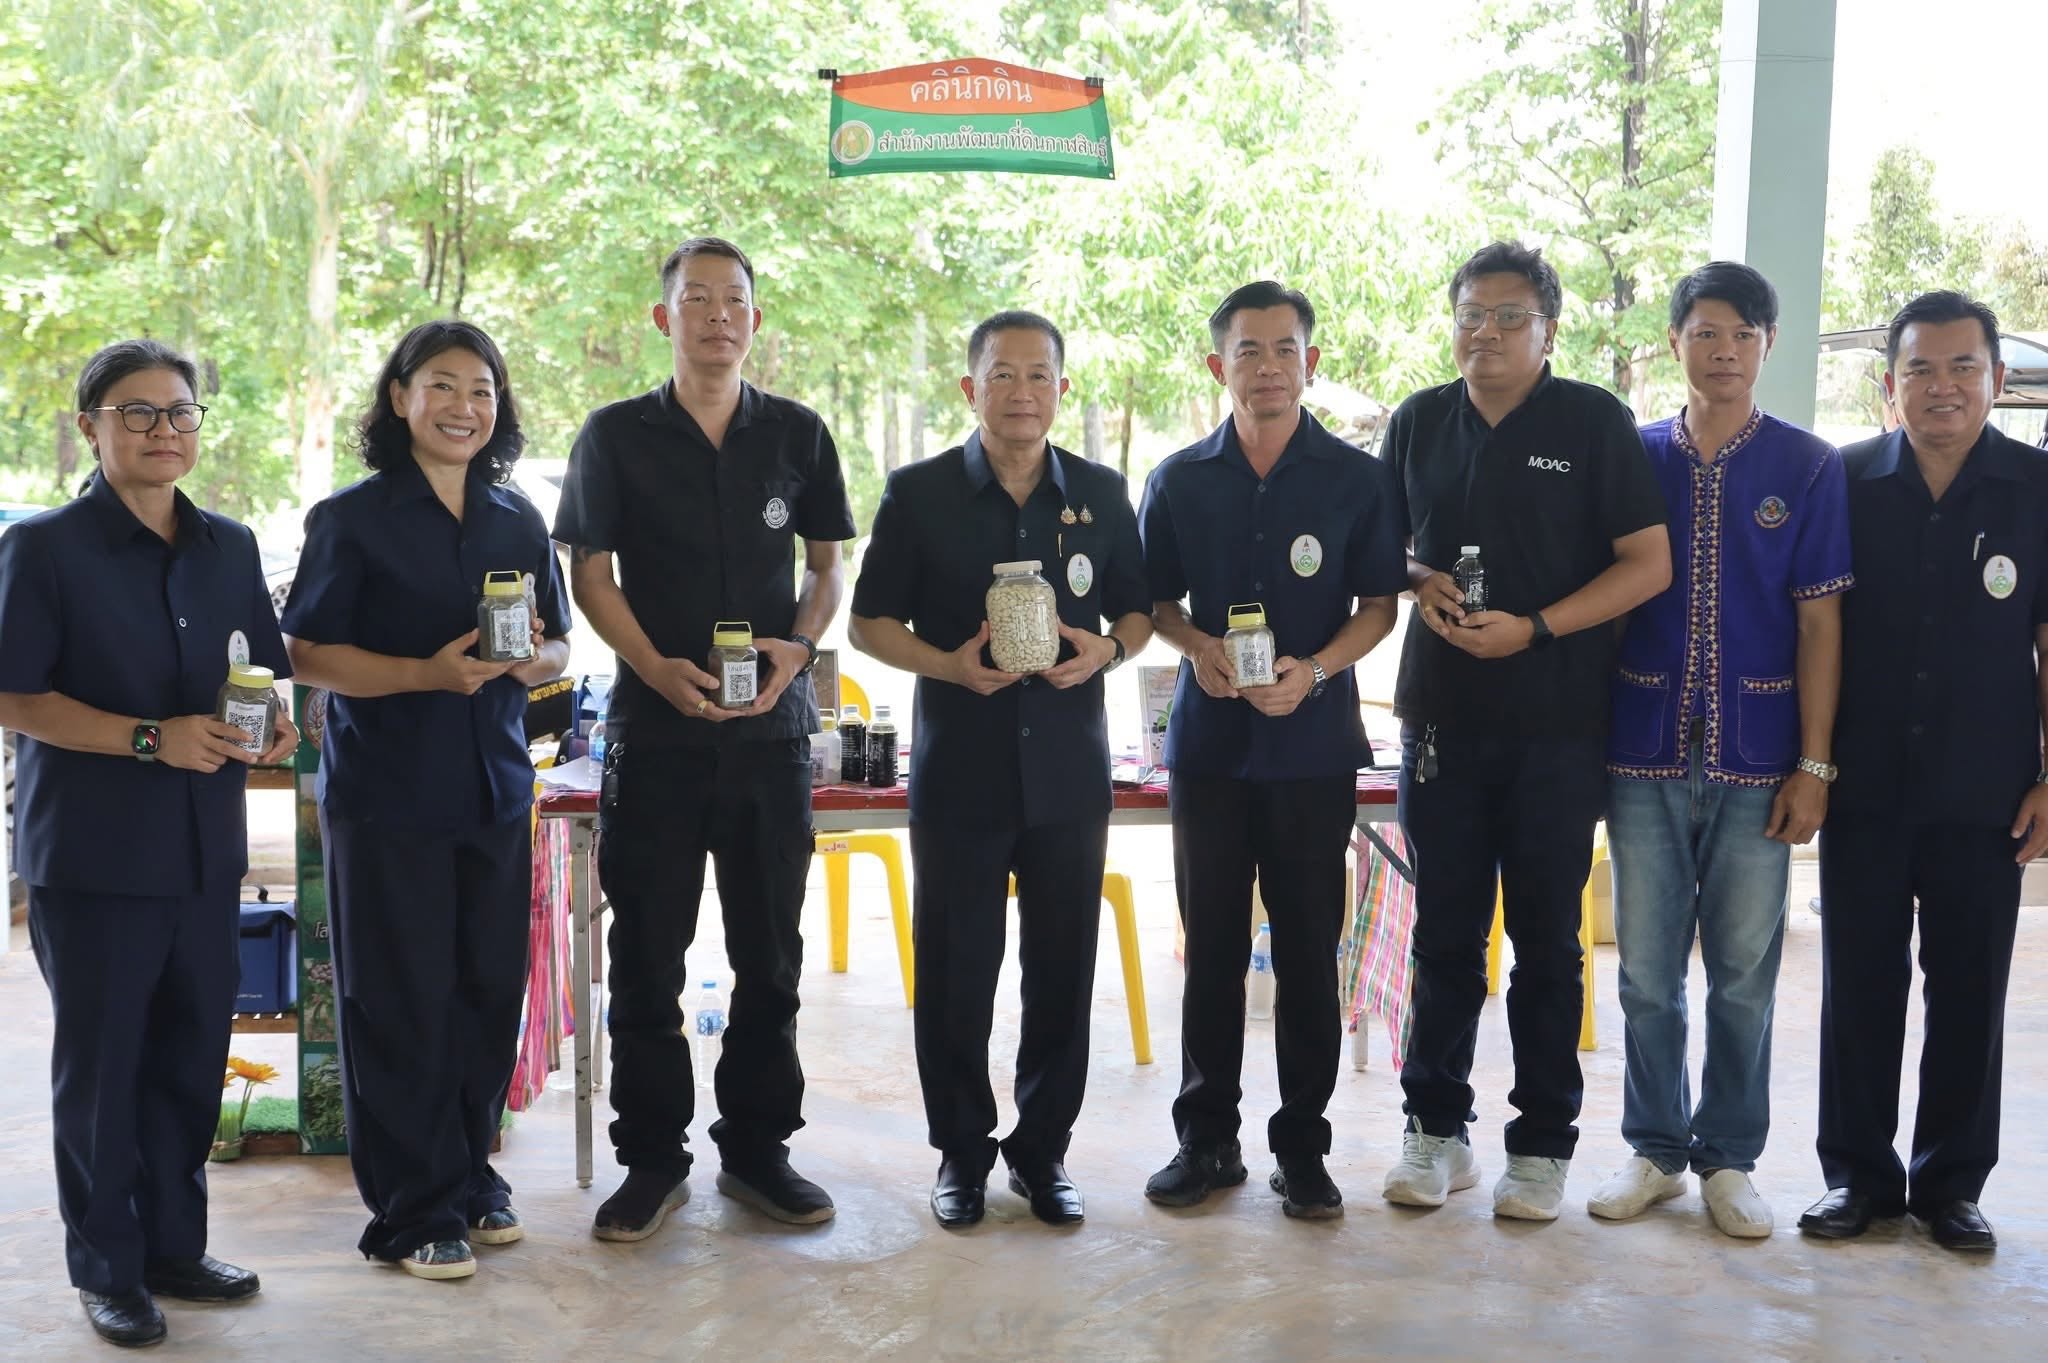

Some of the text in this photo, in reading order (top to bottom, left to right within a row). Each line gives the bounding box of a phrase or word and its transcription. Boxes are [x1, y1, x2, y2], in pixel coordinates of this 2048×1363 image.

[910, 66, 1033, 104] คลินิกดิน
[878, 119, 1109, 166] สำนักงานพัฒนาที่ดินกาฬสินธุ์
[1527, 455, 1571, 473] MOAC
